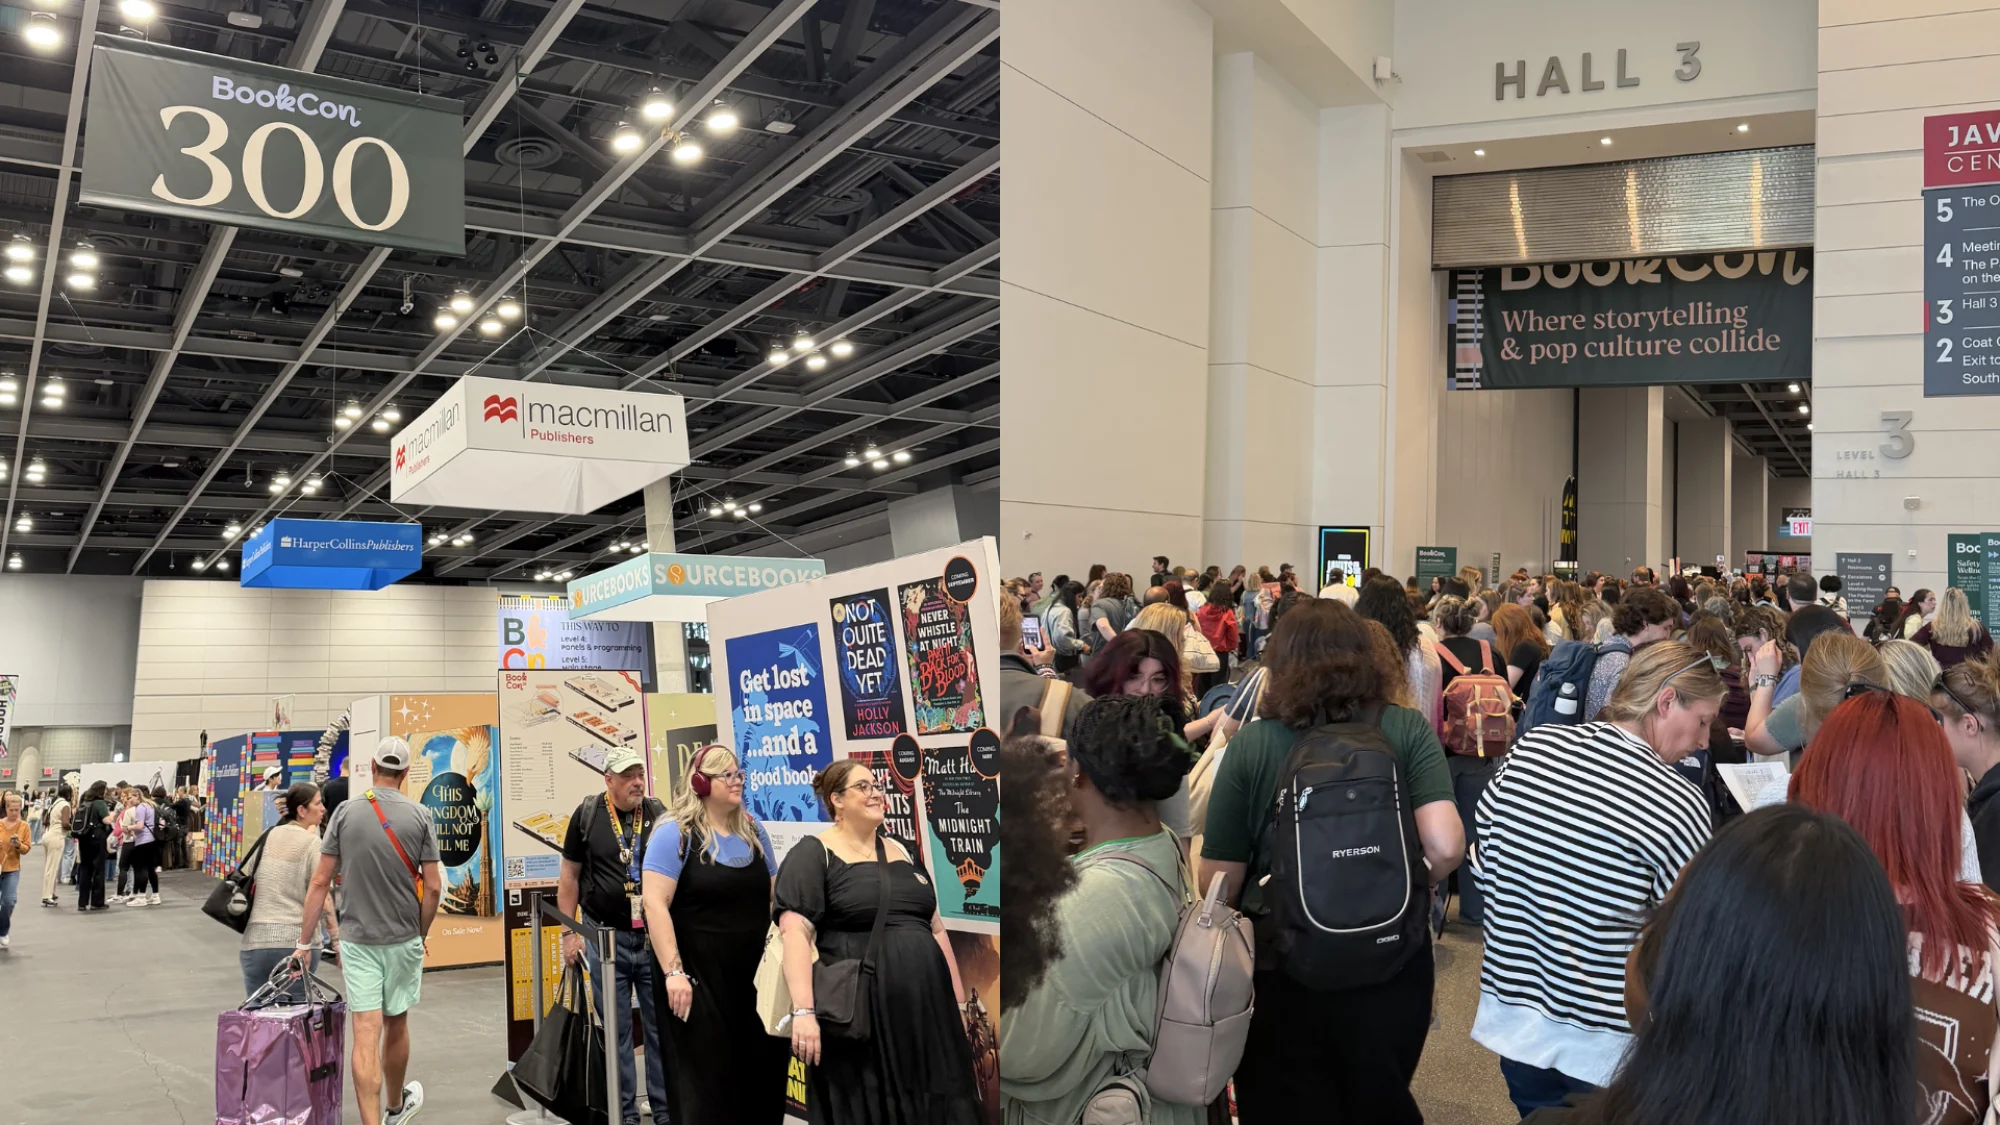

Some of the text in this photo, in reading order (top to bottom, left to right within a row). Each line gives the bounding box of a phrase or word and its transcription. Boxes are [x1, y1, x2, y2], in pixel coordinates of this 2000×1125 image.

[1495, 41, 1701, 101] HALL 3
[212, 76, 362, 128] BookCon
[151, 105, 410, 231] 300
[1936, 198, 1953, 222] 5
[1962, 196, 1986, 208] The
[1936, 243, 1953, 267] 4
[1962, 259, 1986, 271] The
[1962, 273, 2000, 284] on the
[1962, 297, 1998, 309] Hall 3
[1502, 301, 1748, 333] Where storytelling
[1936, 299, 1954, 325] 3
[1500, 328, 1781, 365] & pop culture collide
[1936, 337, 1953, 363] 2
[1962, 337, 1993, 349] Coat
[1962, 355, 1987, 367] Exit
[1962, 372, 2000, 385] South
[528, 402, 672, 434] macmillan
[408, 402, 459, 461] macmillan
[530, 429, 594, 445] Publishers
[1837, 411, 1915, 460] LEVEL 3
[1837, 470, 1880, 479] HALL 3
[1793, 521, 1809, 534] EXIT
[292, 537, 414, 552] HarperCollinsPublishers
[845, 599, 875, 623] NOT
[921, 609, 949, 624] NEVER
[561, 622, 620, 631] THIS WAY TO
[917, 622, 957, 639] WHISTLE
[843, 622, 886, 650] QUITE
[920, 635, 958, 652] AT NIGHT
[847, 647, 887, 671] DEAD
[506, 672, 527, 681] Book
[740, 664, 809, 694] Get lost
[855, 671, 882, 694] YET
[744, 698, 813, 727] in space
[857, 706, 889, 721] HOLLY
[853, 721, 899, 736] JACKSON
[804, 732, 818, 754] a
[925, 755, 976, 775] Matt Ha
[750, 764, 818, 792] good book
[432, 784, 463, 802] THIS
[430, 804, 479, 824] INGDOM
[954, 801, 969, 814] The
[435, 823, 474, 835] ILL NOT
[883, 818, 916, 840] STILL
[938, 818, 991, 834] MIDNIGHT
[437, 839, 469, 851] ILL ME
[950, 838, 984, 853] TRAIN
[1332, 845, 1380, 859] RYERSON
[442, 928, 451, 936] On
